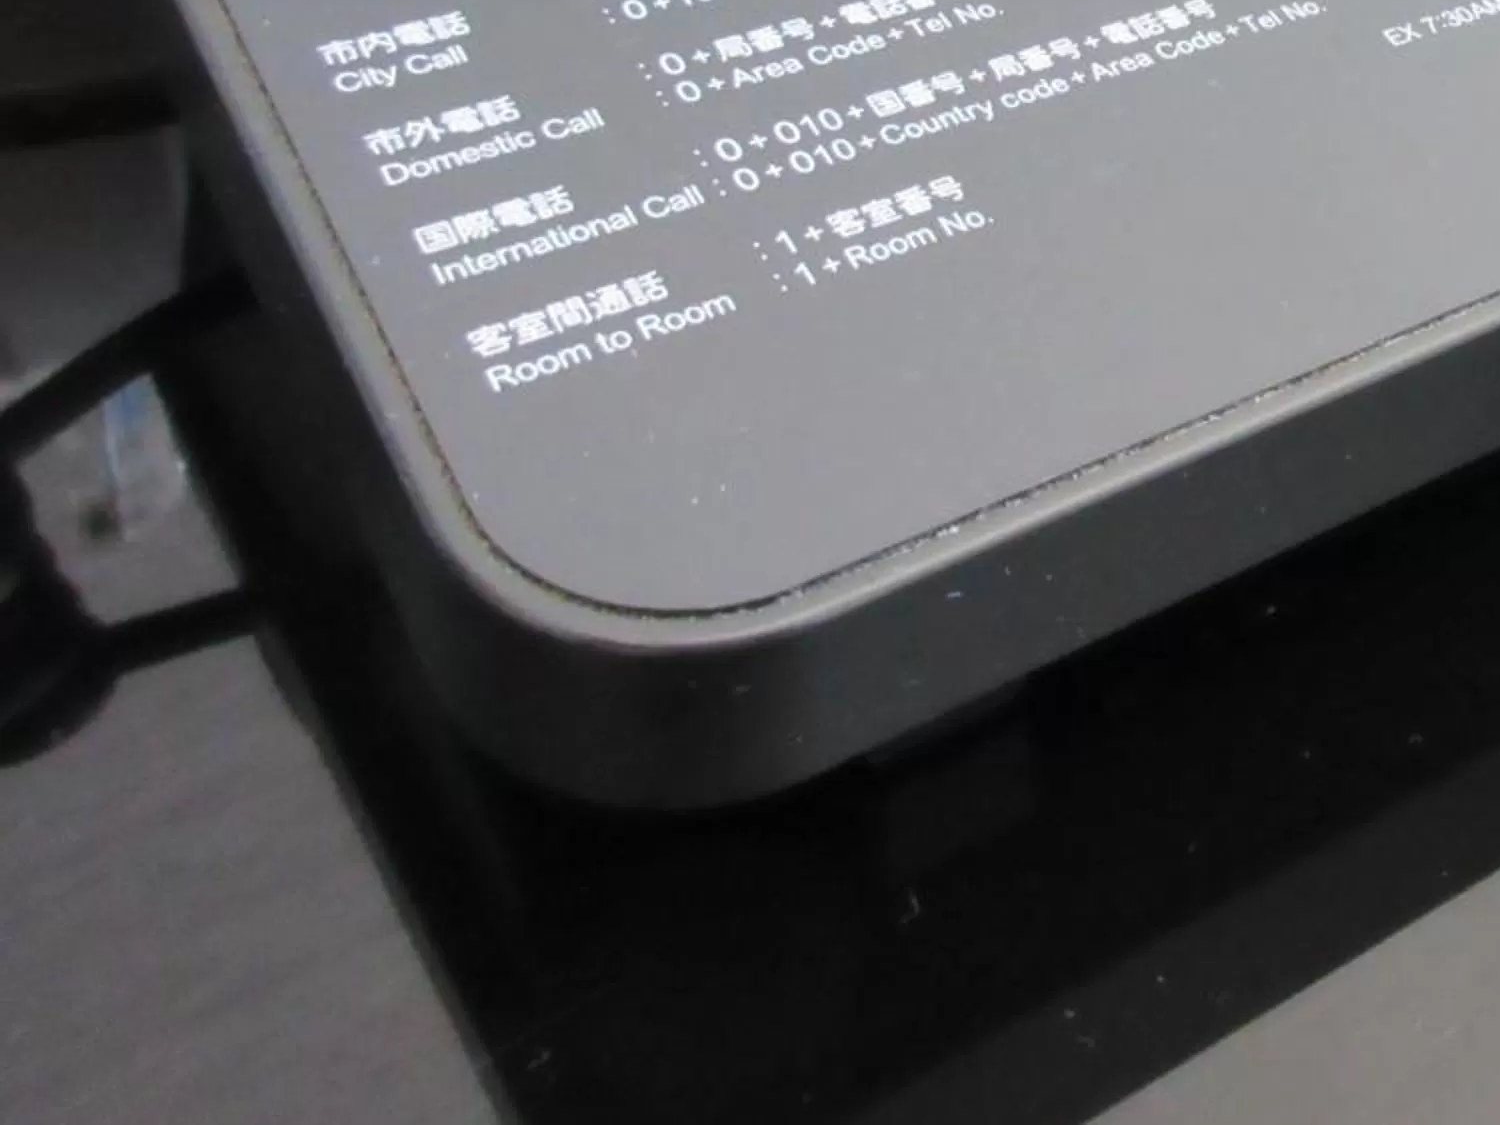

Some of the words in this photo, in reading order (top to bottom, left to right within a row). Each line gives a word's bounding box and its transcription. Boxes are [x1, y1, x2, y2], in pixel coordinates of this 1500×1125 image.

[316, 10, 472, 67] 市内電話
[953, 1, 1005, 25] No.
[1383, 22, 1422, 47] EX
[332, 63, 398, 93] City
[405, 44, 469, 75] Call
[363, 94, 522, 157] 市外電話
[380, 128, 537, 186] Domestic
[540, 107, 605, 140] Call
[412, 185, 576, 255] 国際電話
[431, 204, 638, 286] International
[641, 184, 706, 219] Call
[937, 211, 996, 237] No.
[466, 270, 670, 358] 客室間通話
[484, 340, 592, 393] Room
[595, 324, 633, 356] to
[635, 292, 737, 340] Room
